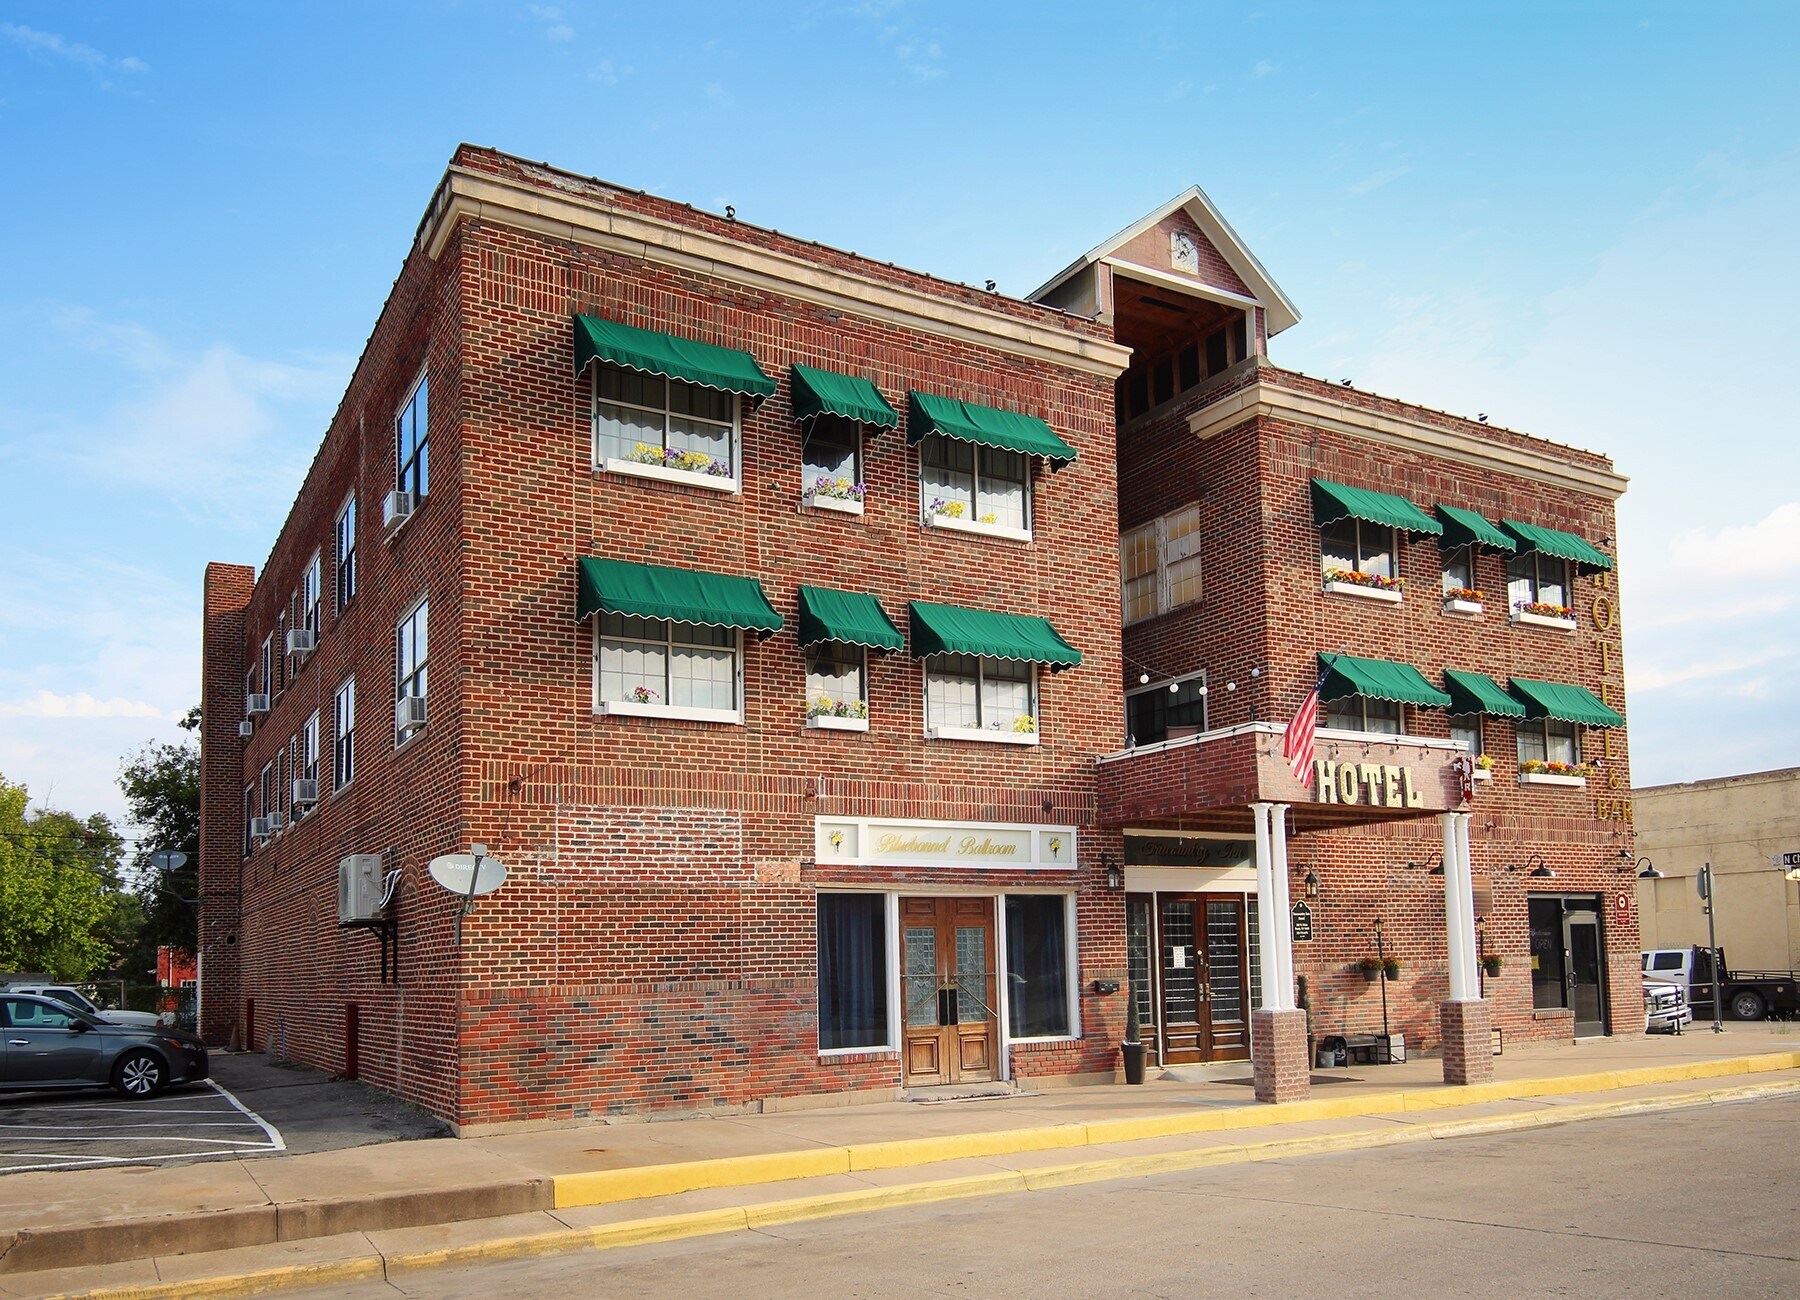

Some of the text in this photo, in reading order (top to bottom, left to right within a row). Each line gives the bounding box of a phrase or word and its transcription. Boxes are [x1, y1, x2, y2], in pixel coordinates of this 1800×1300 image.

[1314, 760, 1424, 809] HOTEL
[1608, 767, 1622, 790] &
[1597, 798, 1634, 821] BAR
[876, 832, 1018, 856] Bluebonnet Ballroom
[1217, 842, 1246, 859] Inn
[1784, 855, 1790, 864] N
